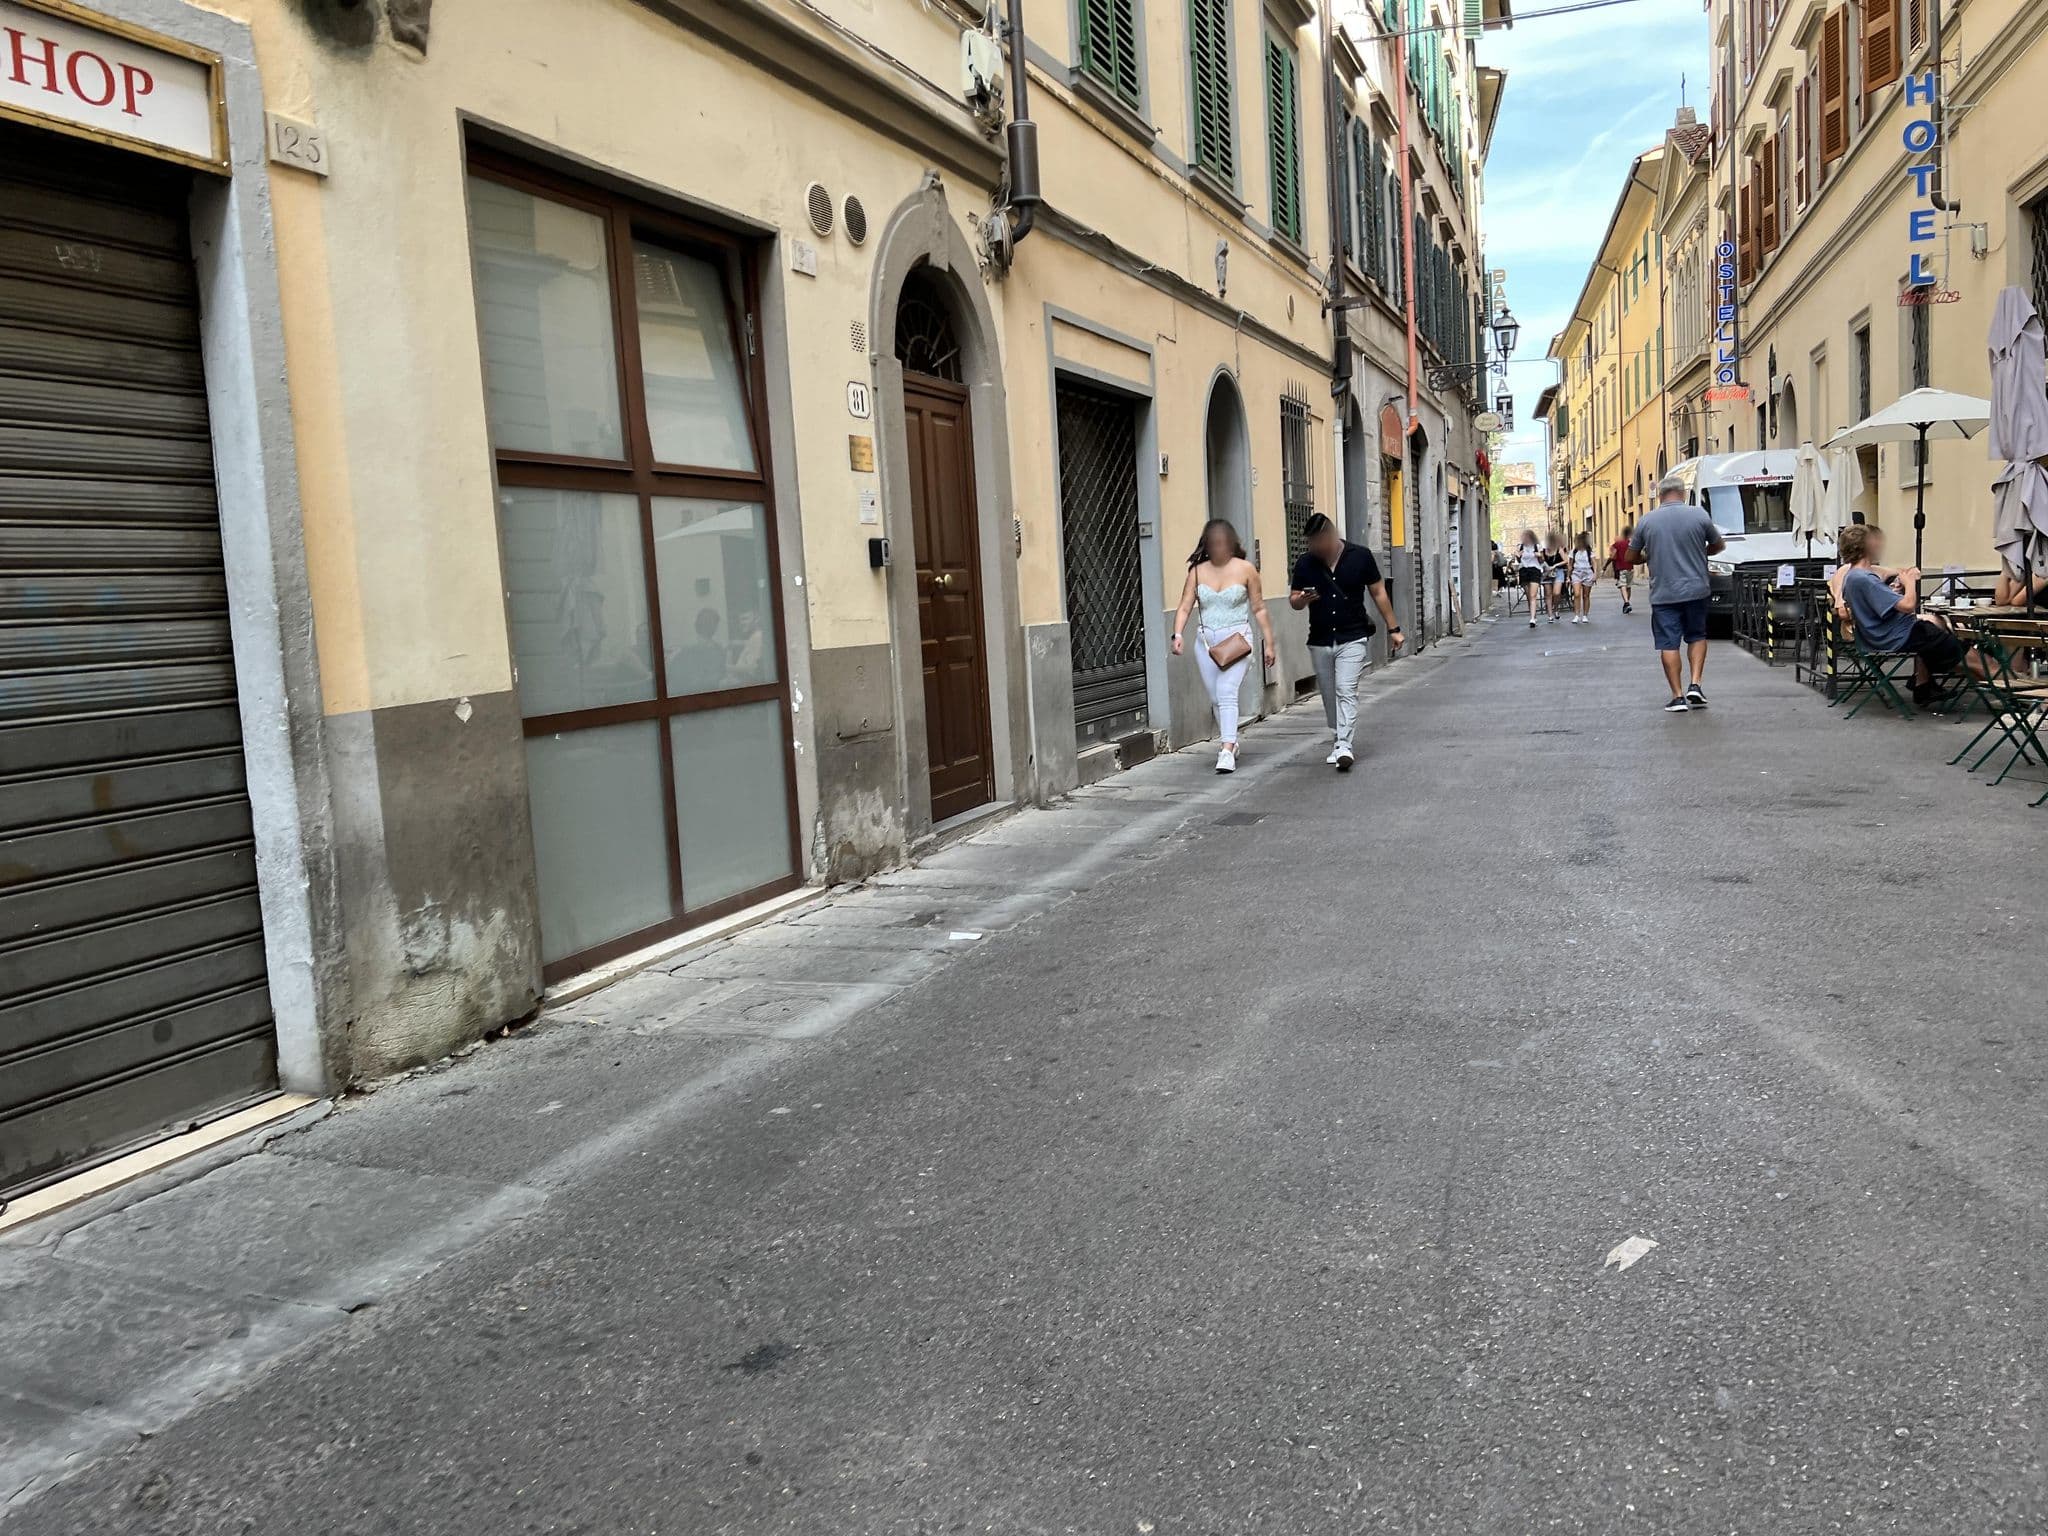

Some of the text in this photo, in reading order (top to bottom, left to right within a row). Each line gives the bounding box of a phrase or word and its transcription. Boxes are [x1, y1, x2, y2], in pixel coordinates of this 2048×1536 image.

[0, 27, 154, 117] HOP
[275, 122, 320, 163] 125
[1903, 72, 1938, 286] HOTEL
[1718, 242, 1735, 384] OSTELLO
[852, 389, 865, 412] 81
